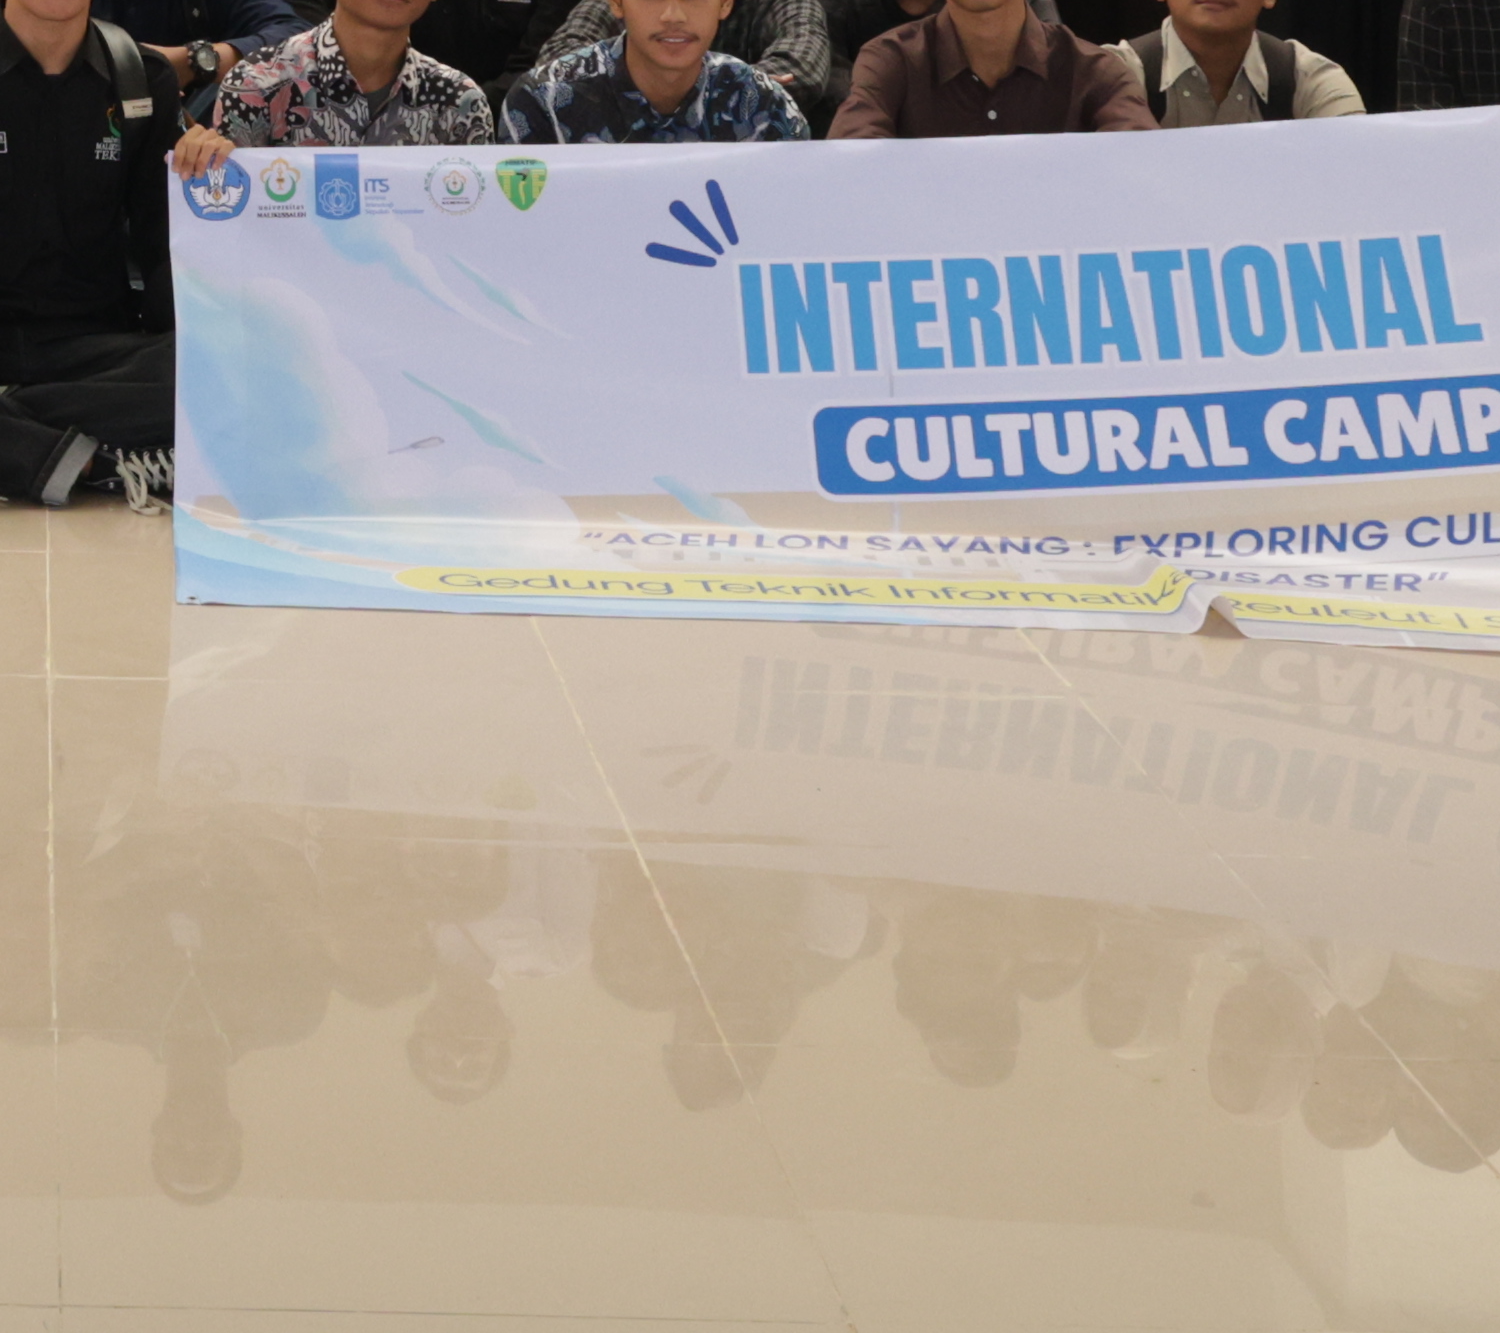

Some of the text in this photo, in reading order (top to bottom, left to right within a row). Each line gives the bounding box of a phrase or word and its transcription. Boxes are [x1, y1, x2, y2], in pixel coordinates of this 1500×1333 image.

[740, 230, 1482, 375] INTERNATIONAL
[845, 401, 1248, 483] CULTURAL
[755, 533, 850, 551] LON
[864, 535, 1071, 557] SAYANG
[1112, 519, 1390, 559] EXPLORING
[438, 573, 674, 596] Gedung
[685, 579, 875, 600] Teknik
